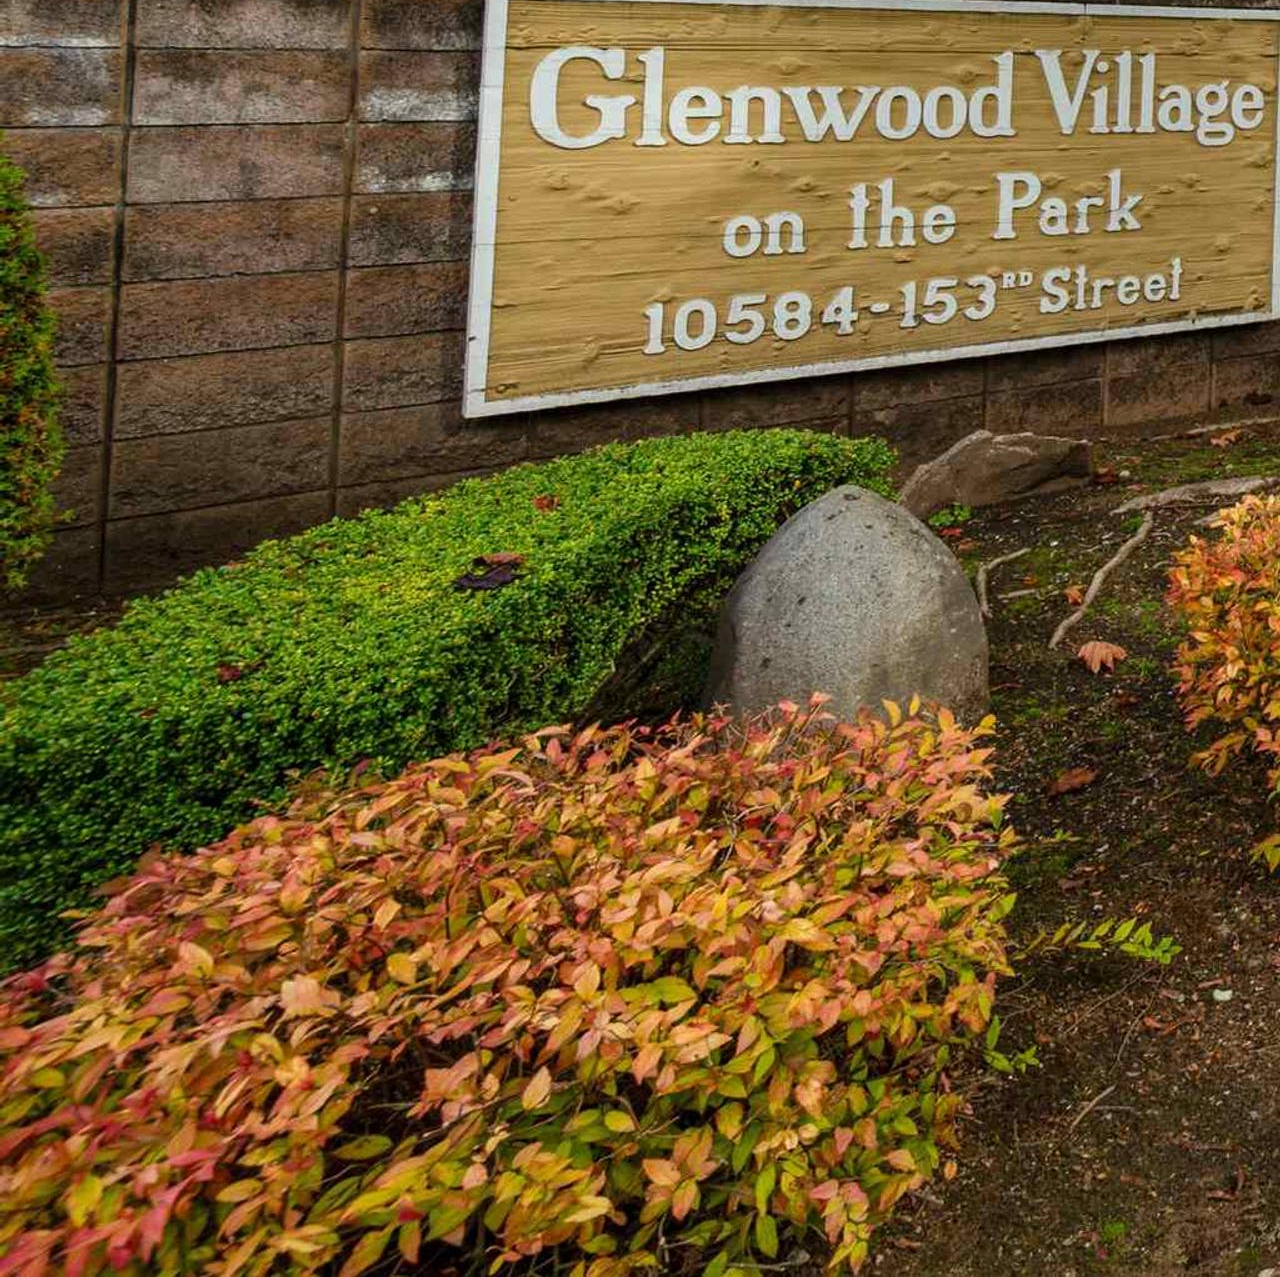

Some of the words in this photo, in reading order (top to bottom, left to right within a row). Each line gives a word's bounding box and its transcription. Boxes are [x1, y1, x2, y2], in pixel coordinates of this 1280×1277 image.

[529, 45, 1016, 150] Glenwood
[1034, 49, 1265, 146] Village
[722, 210, 807, 258] on
[847, 177, 956, 249] the
[992, 168, 1144, 240] Park
[1039, 257, 1184, 315] Street
